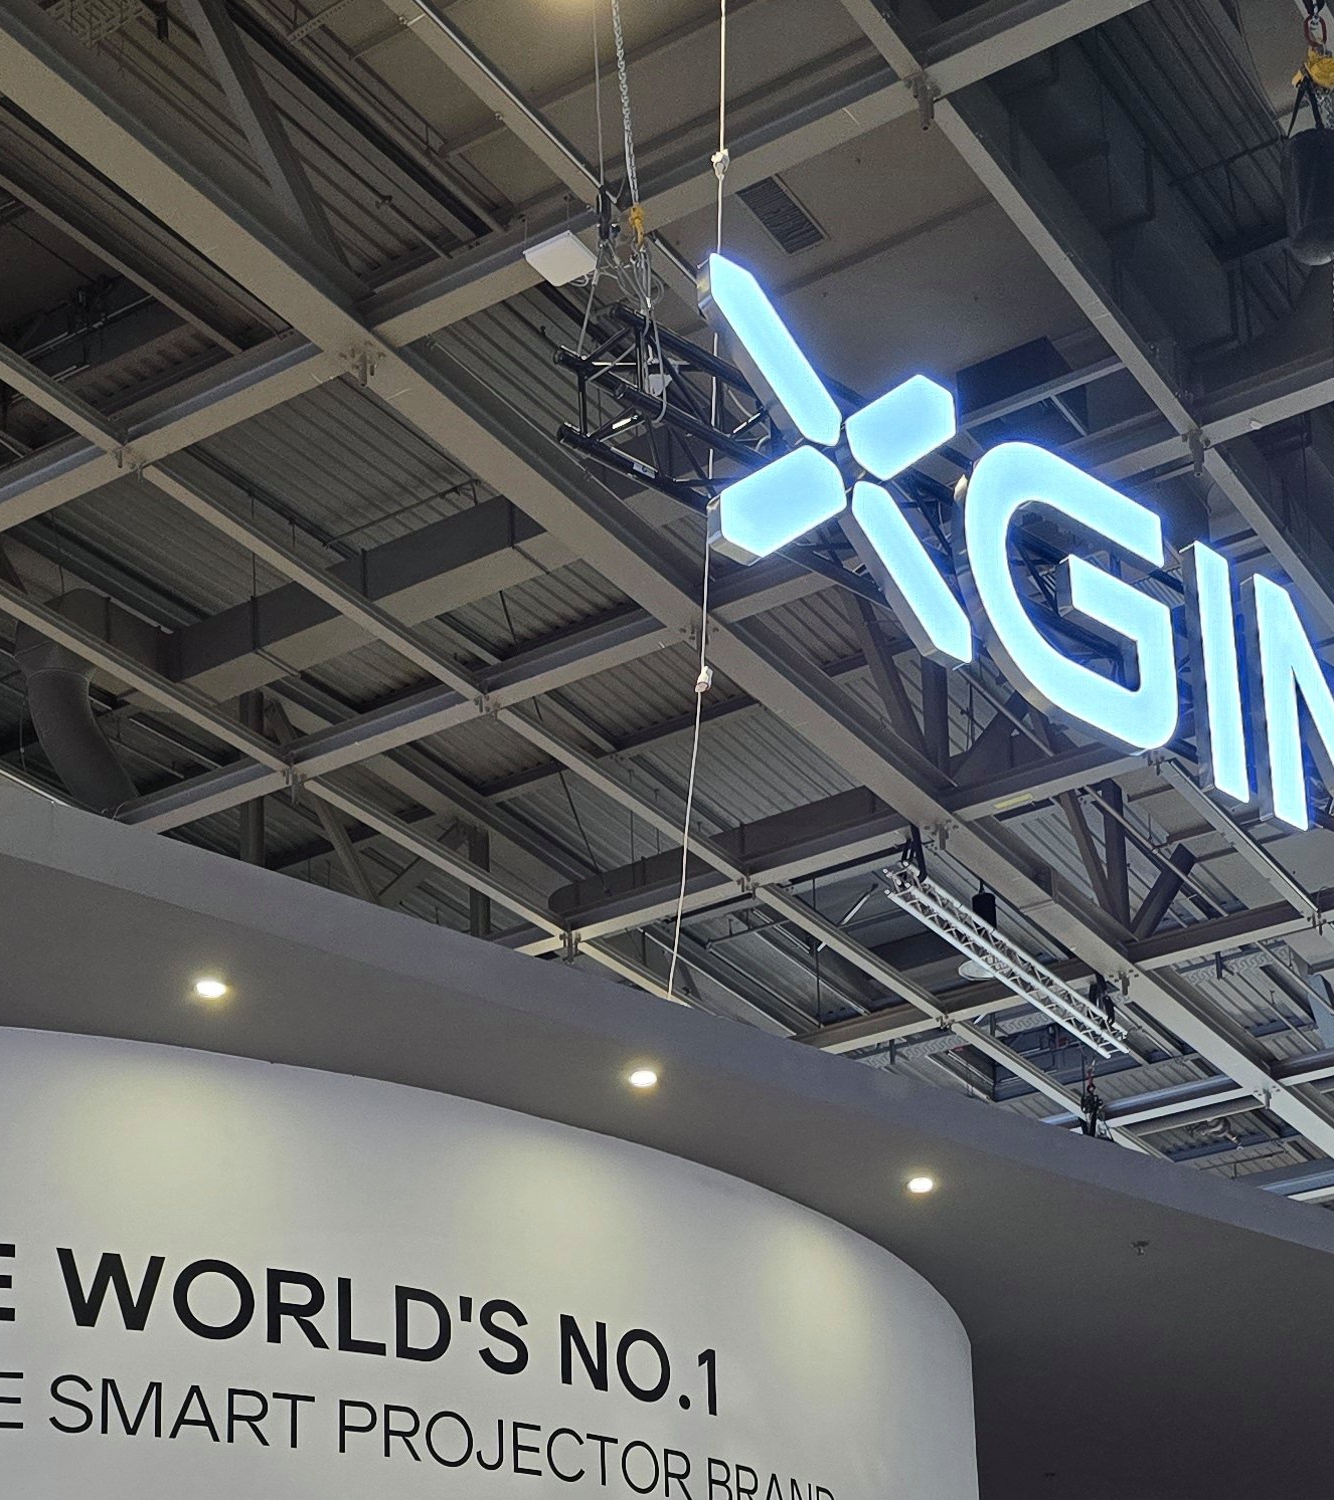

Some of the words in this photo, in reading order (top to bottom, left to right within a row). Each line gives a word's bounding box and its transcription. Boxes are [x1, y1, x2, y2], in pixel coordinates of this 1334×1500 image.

[56, 1247, 529, 1375] WORLD'S
[560, 1313, 718, 1416] NO.1
[49, 1374, 315, 1448] SMART
